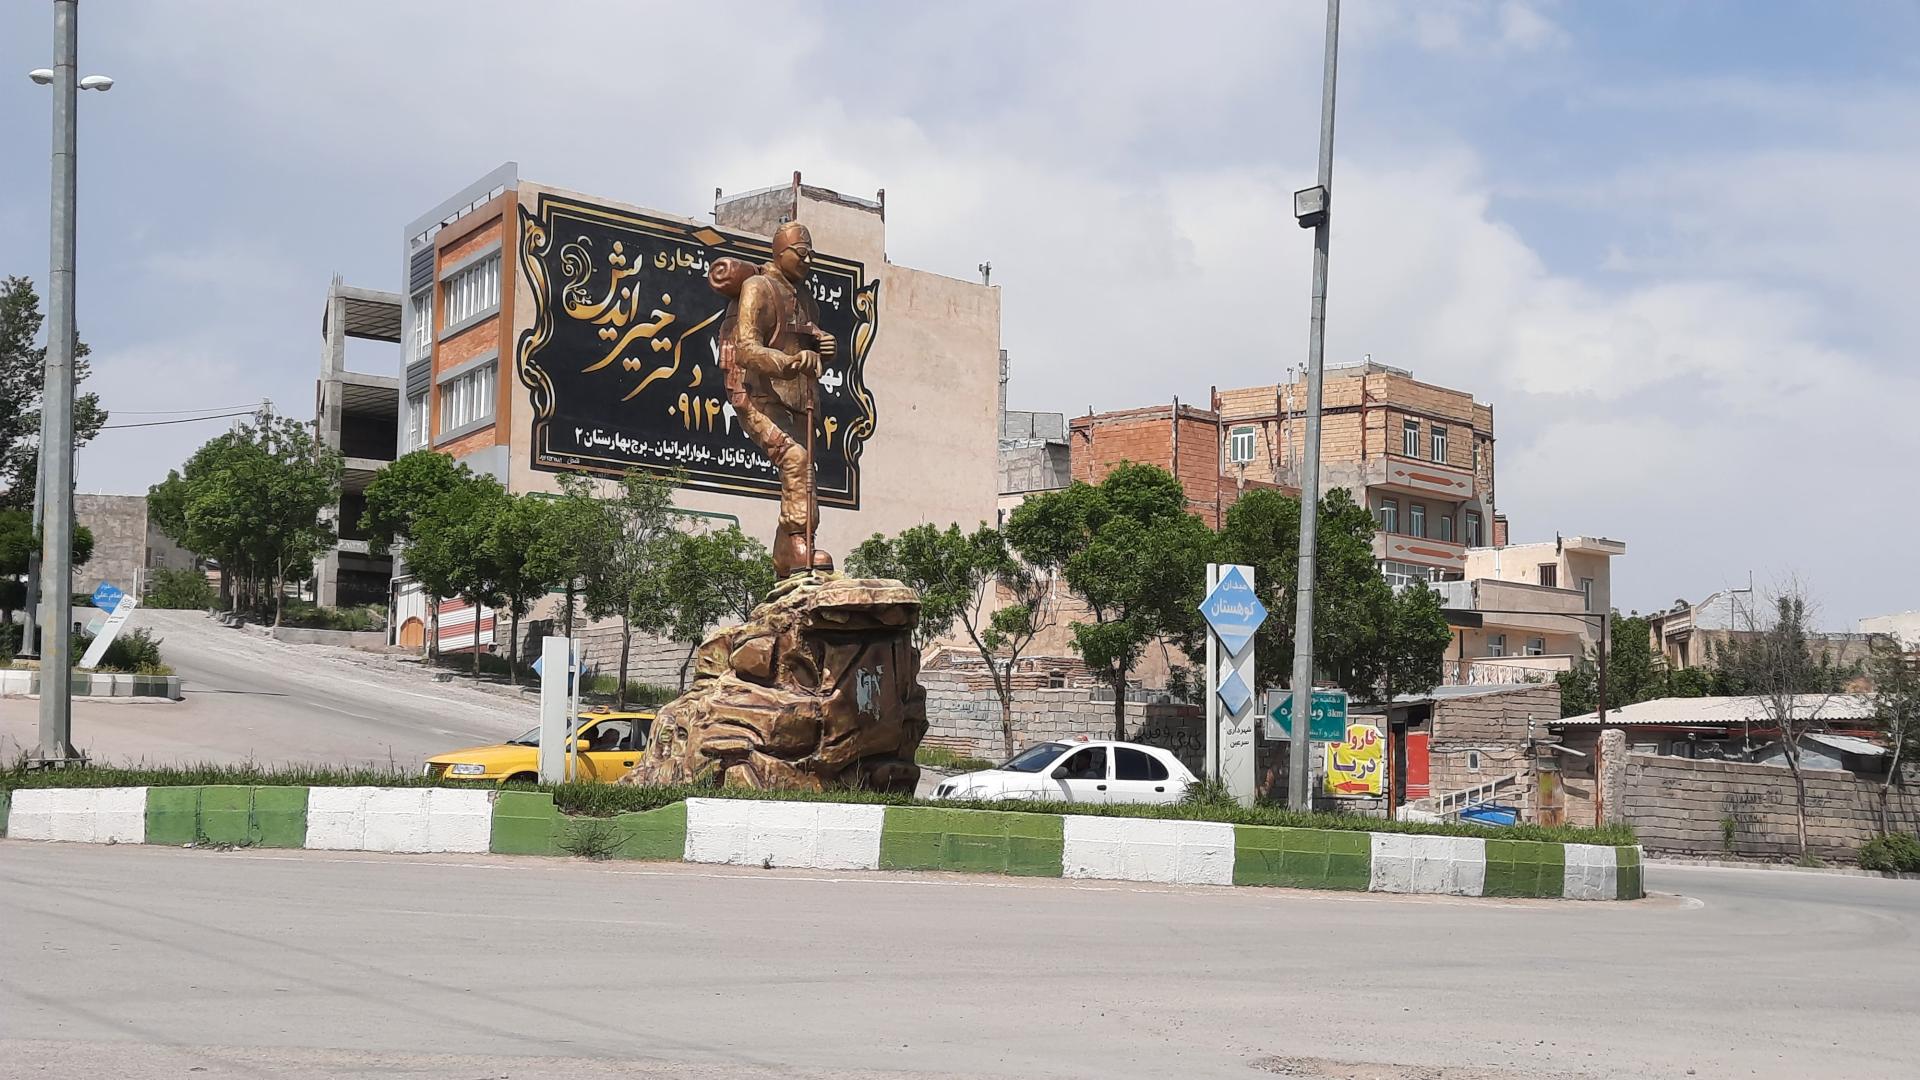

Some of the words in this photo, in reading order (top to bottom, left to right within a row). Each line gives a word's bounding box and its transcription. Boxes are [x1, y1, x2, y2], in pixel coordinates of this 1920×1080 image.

[1222, 579, 1248, 593] میدان
[1211, 598, 1257, 623] کوهستان
[1226, 725, 1252, 736] شهرداری
[1229, 740, 1250, 749] سرعین
[1332, 751, 1377, 779] دریا
